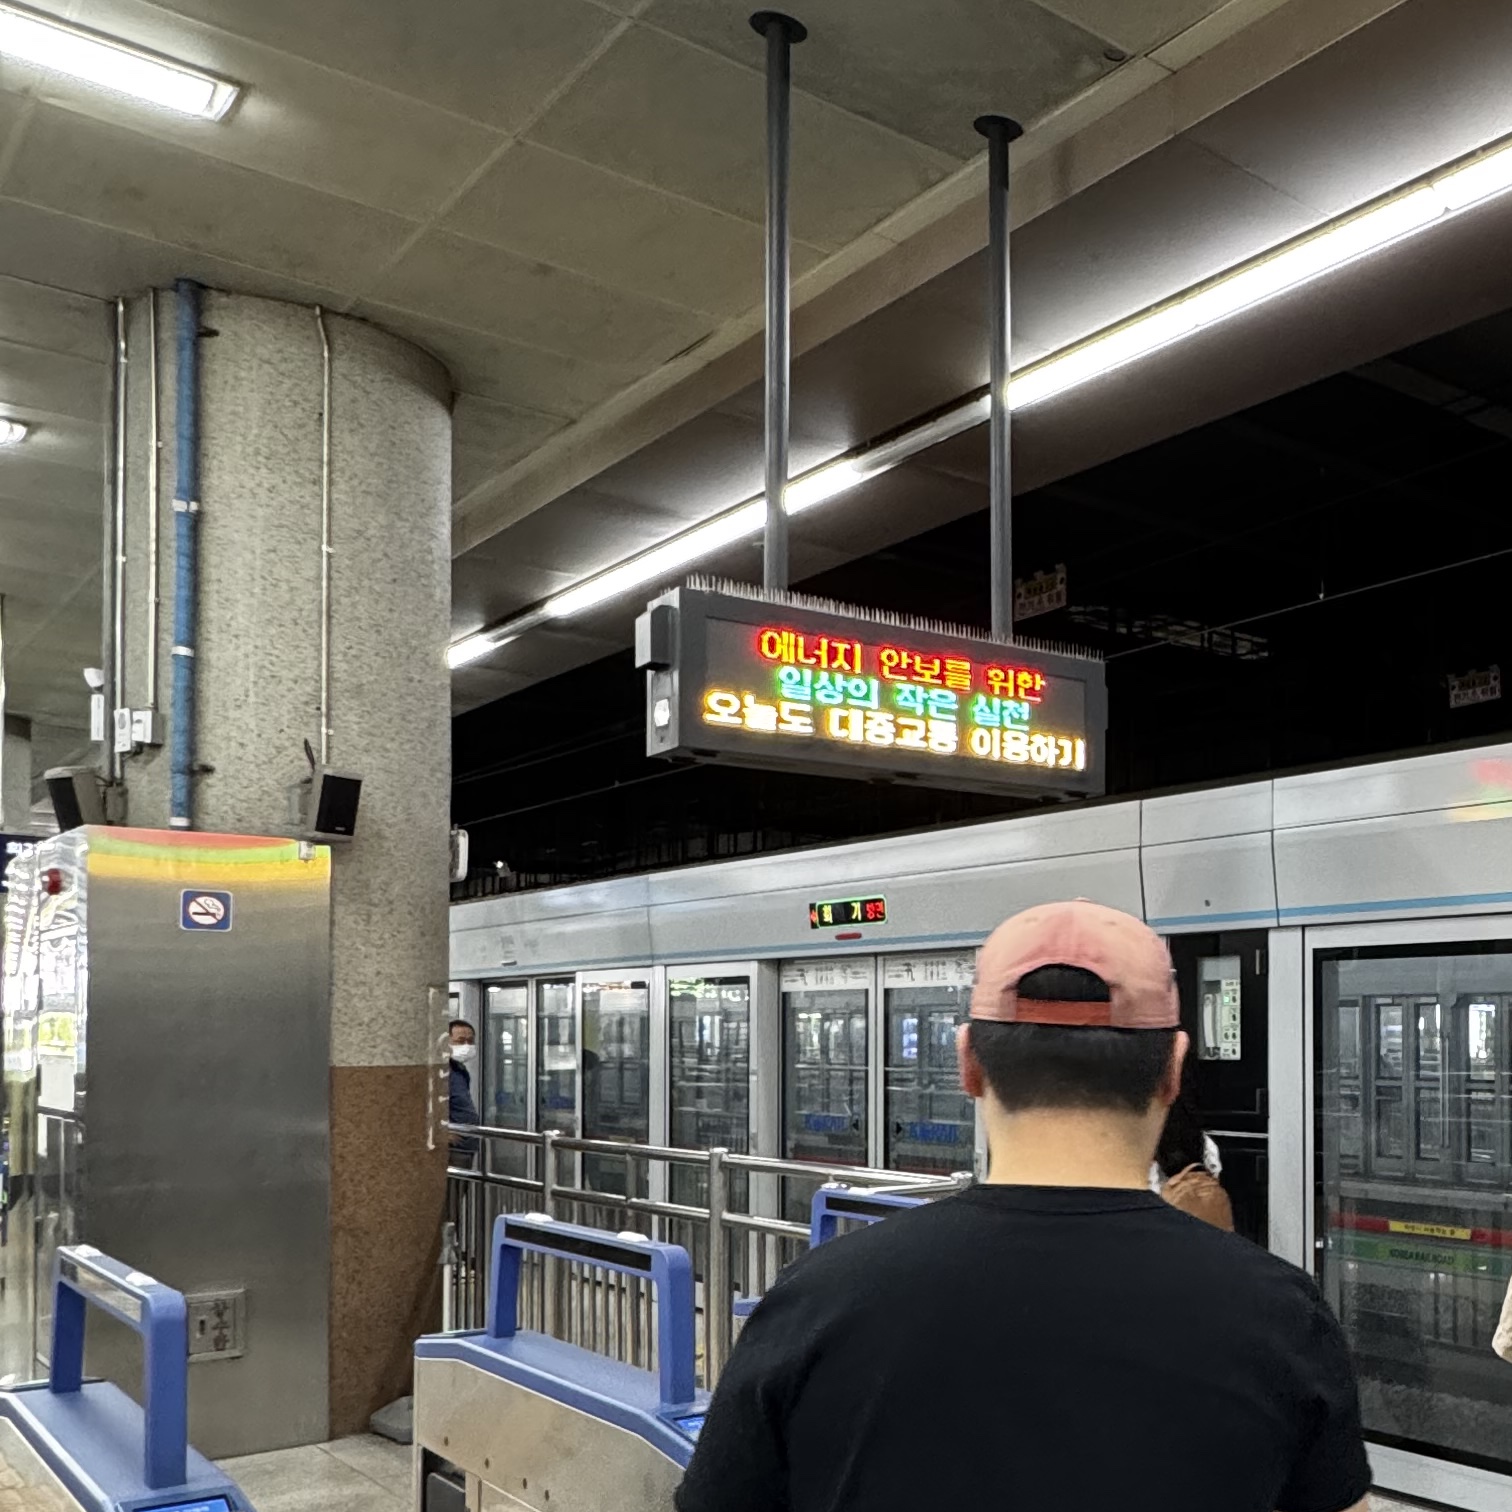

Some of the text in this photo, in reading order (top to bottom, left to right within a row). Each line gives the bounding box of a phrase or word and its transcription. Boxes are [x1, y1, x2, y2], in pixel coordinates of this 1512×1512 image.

[759, 626, 1046, 702] 에너지 안보를 위한
[778, 665, 1031, 731] 일상의 작은 실천
[703, 690, 1087, 772] 오늘도 대중교통 이용하기
